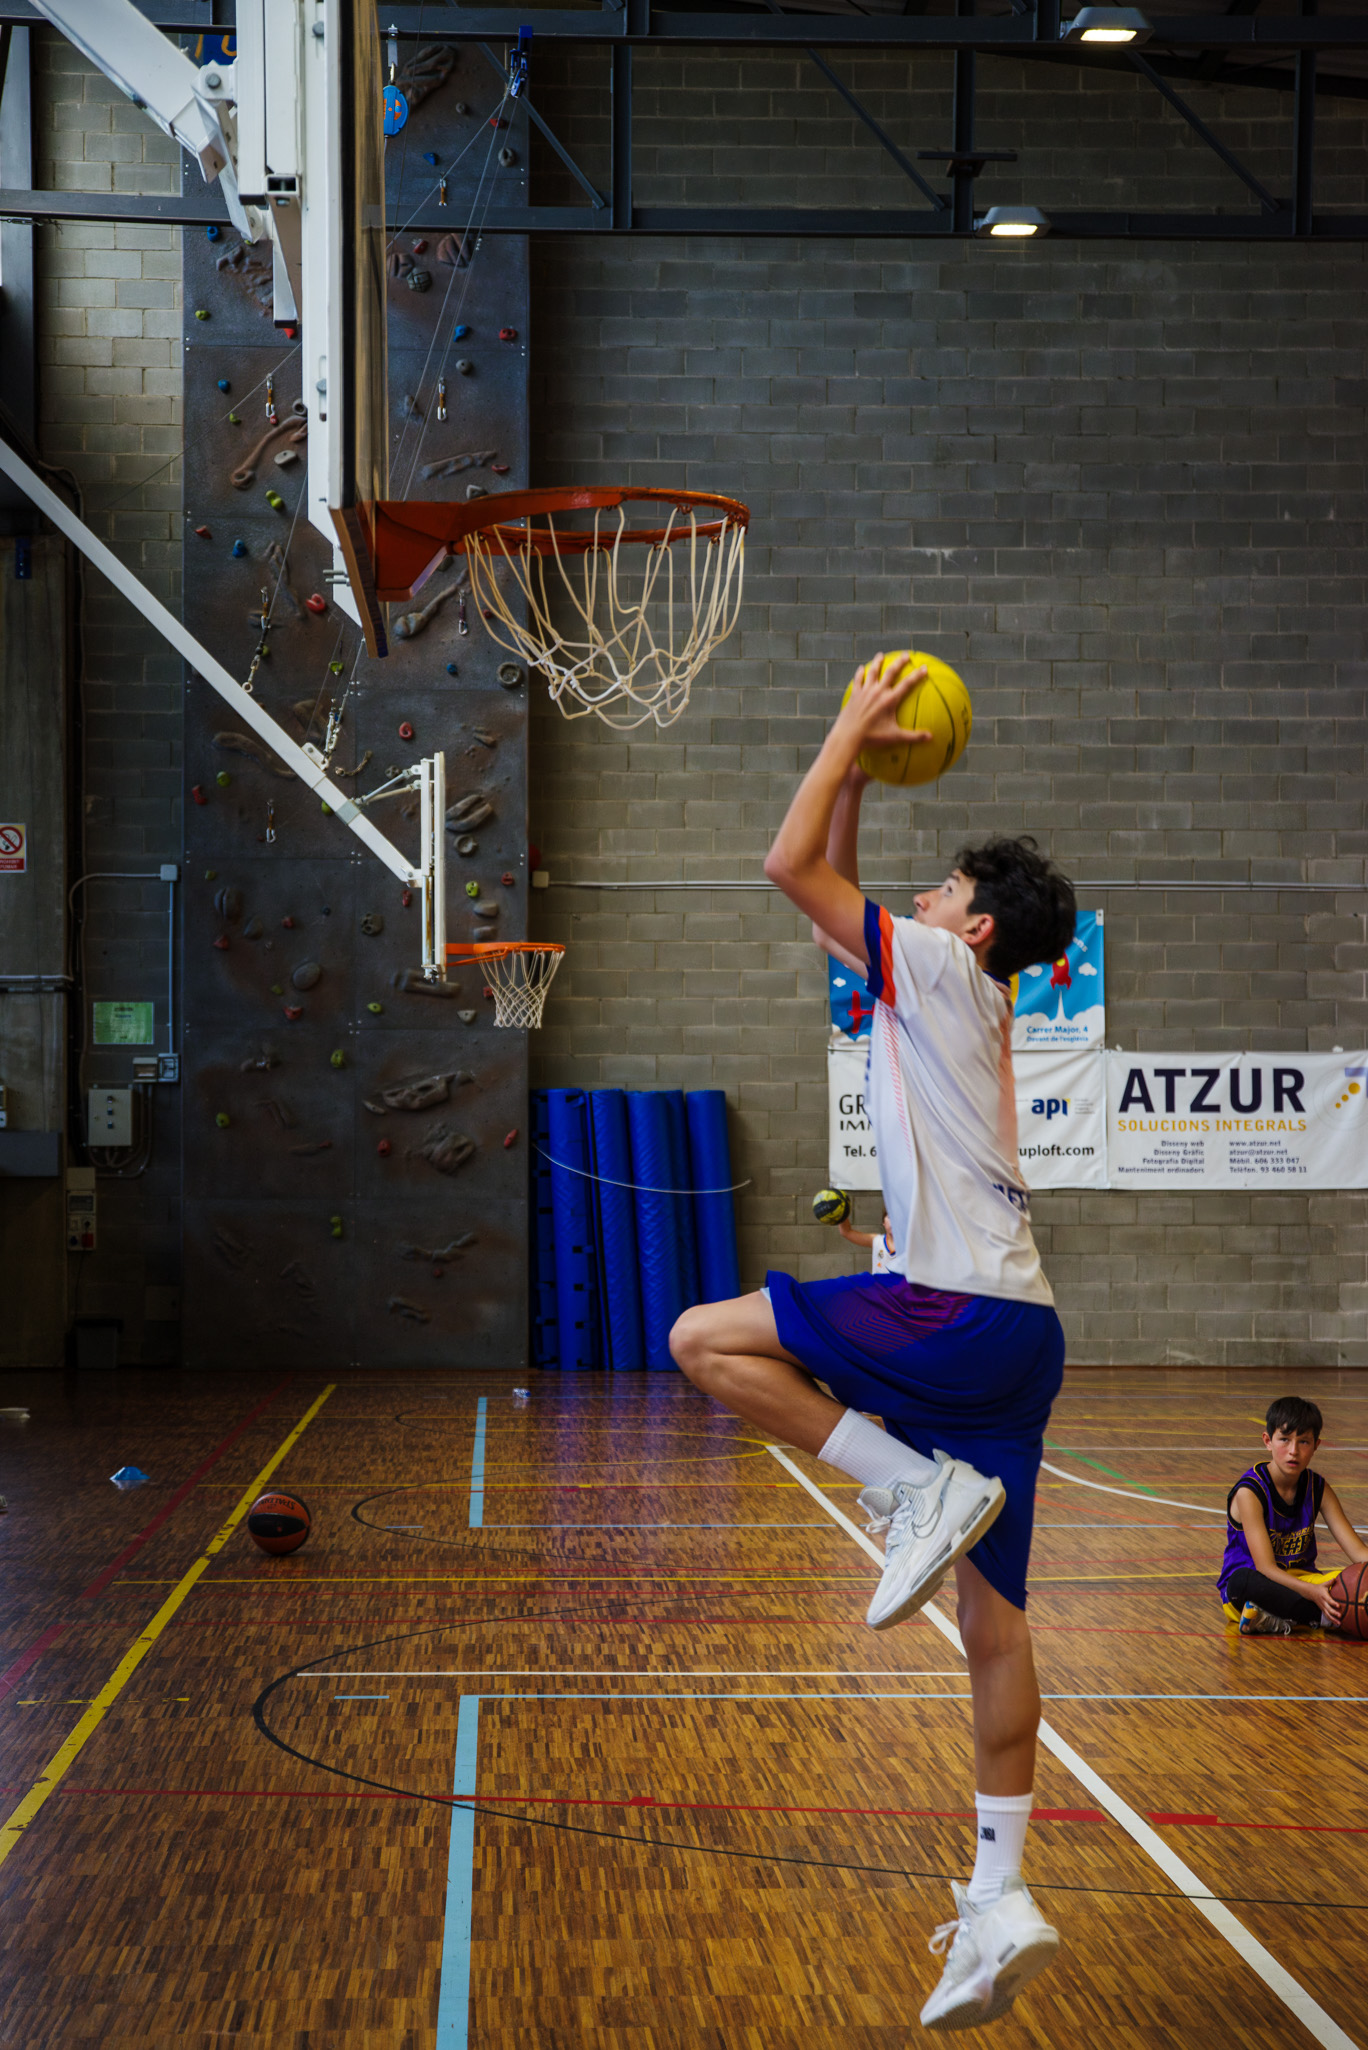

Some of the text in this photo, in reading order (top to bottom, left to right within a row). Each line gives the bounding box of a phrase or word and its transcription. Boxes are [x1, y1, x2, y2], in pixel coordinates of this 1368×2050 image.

[1026, 1025, 1052, 1034] Carrer
[1083, 1025, 1089, 1033] 4
[1118, 1067, 1306, 1113] ATZUR
[1118, 1119, 1307, 1132] SOLUCIONS INTEGRALS
[1161, 1139, 1205, 1148] Disseny web
[843, 1145, 866, 1157] Tel.
[1153, 1148, 1180, 1157] Disseny
[1229, 1148, 1288, 1156] atzur@atzur.net
[1142, 1157, 1205, 1166] Fotografia Digital
[1270, 1157, 1285, 1165] 333
[1118, 1166, 1205, 1174] Manteniment ordinadors
[1260, 1166, 1270, 1174] 93
